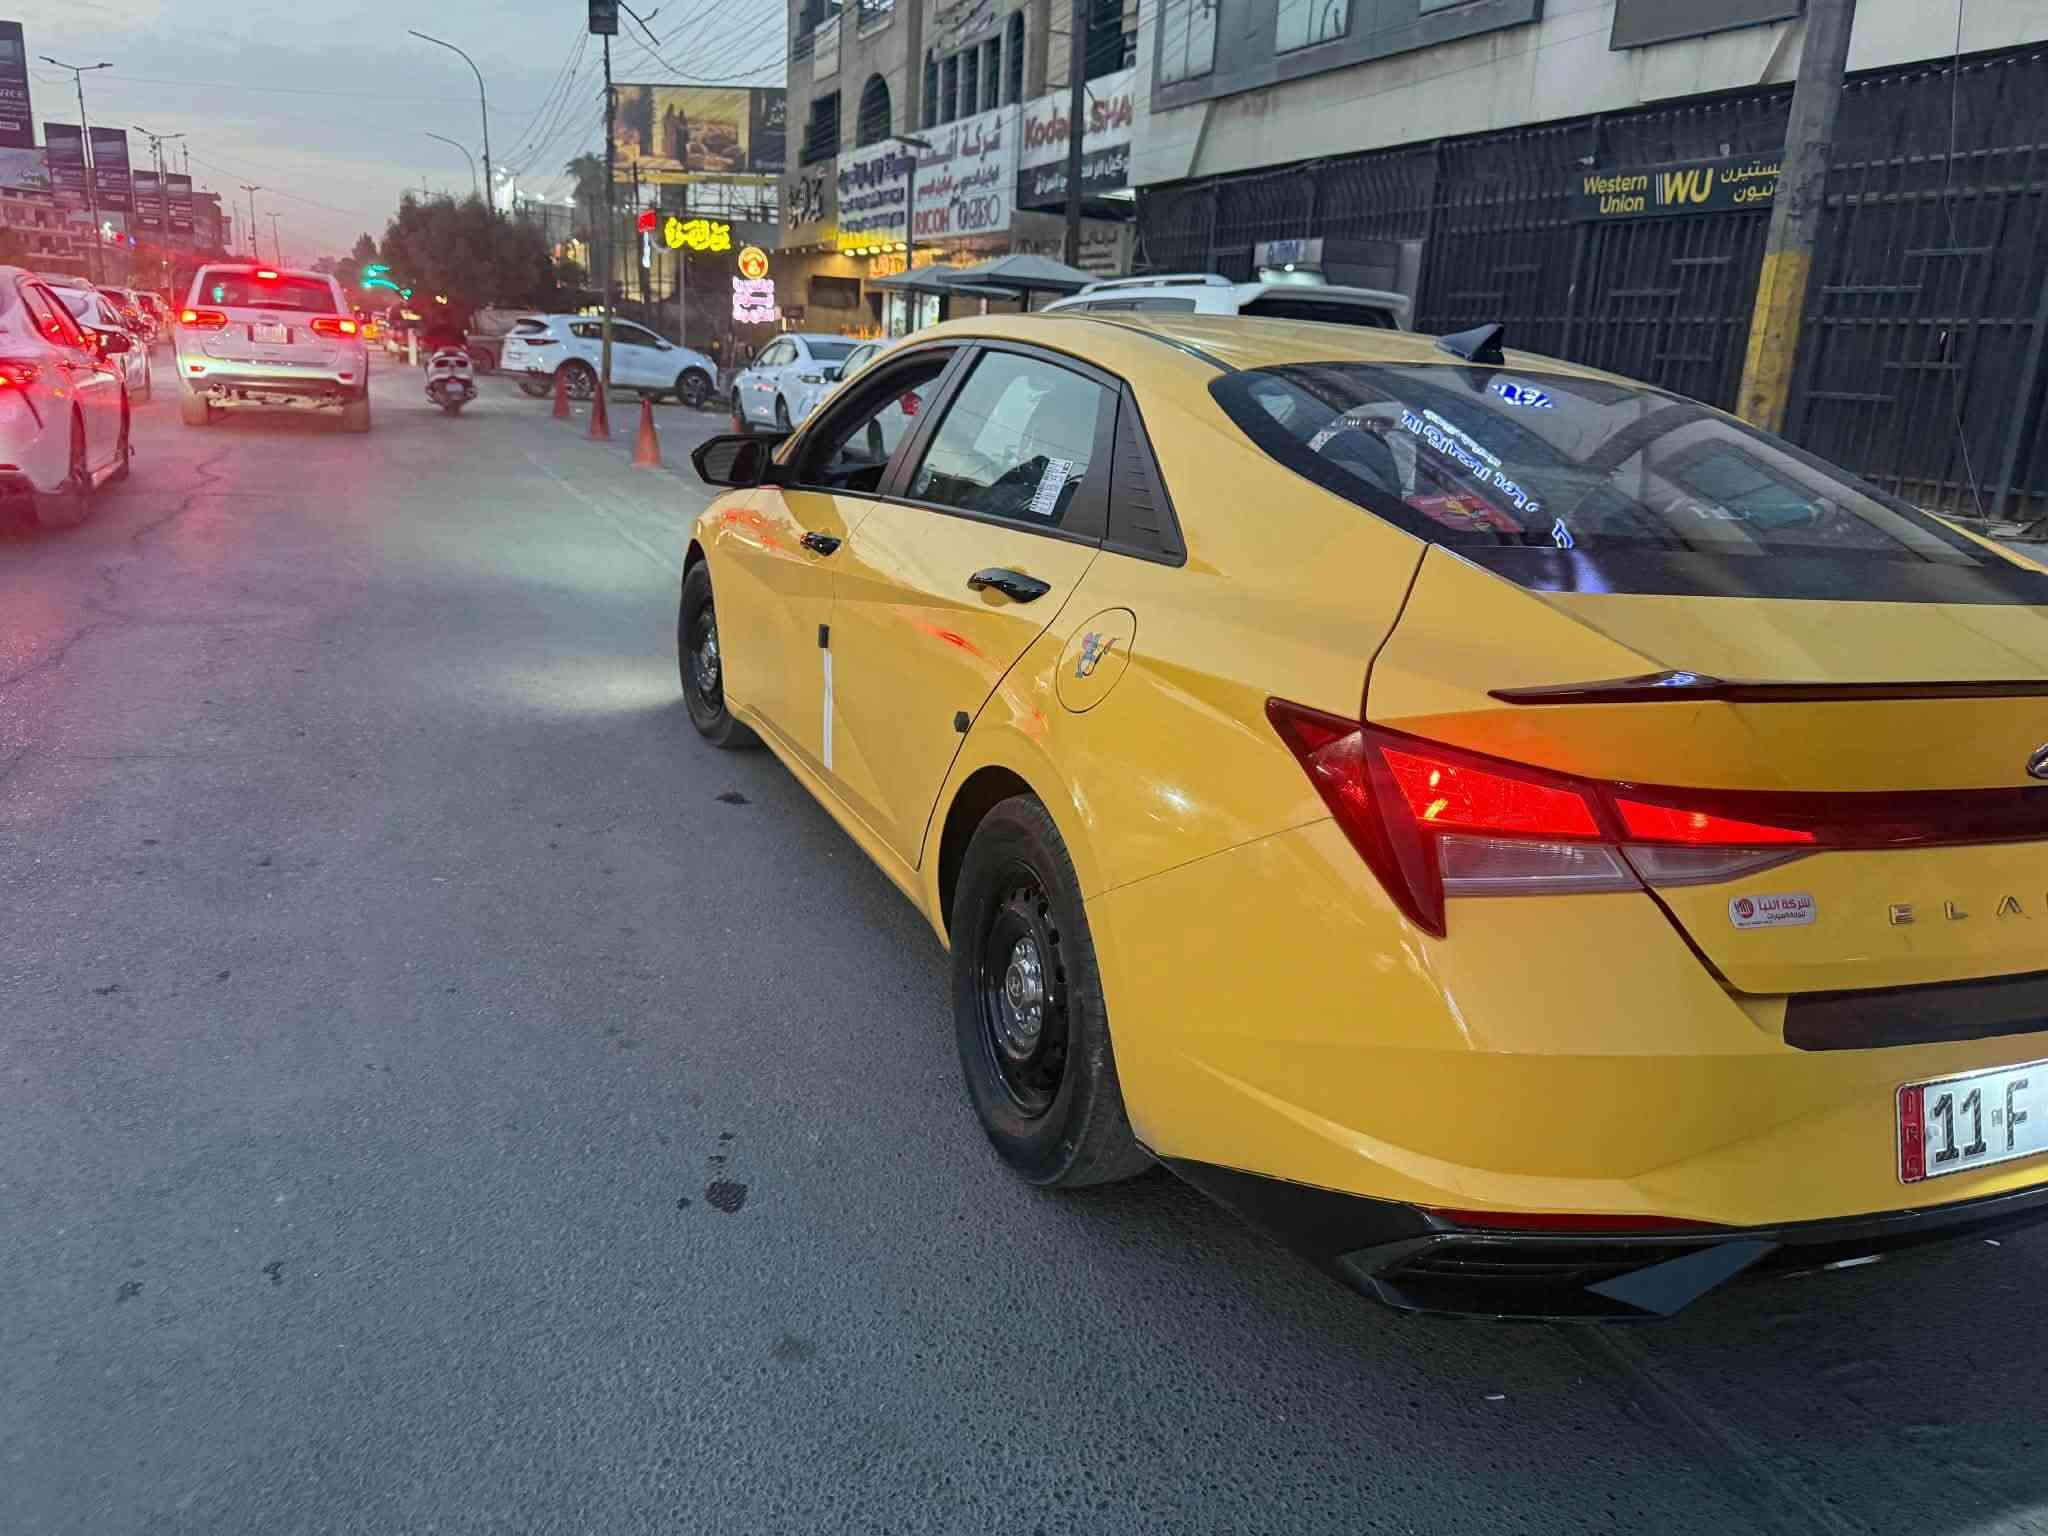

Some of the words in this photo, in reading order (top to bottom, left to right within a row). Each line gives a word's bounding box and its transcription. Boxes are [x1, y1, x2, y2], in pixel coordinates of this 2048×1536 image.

[1024, 107, 1073, 150] Koda
[1584, 175, 1648, 195] Western
[1663, 168, 1714, 205] WU
[1600, 194, 1645, 214] Union
[1889, 892, 2048, 926] ELA
[1933, 1087, 1987, 1163] 11
[2006, 1077, 2029, 1151] F
